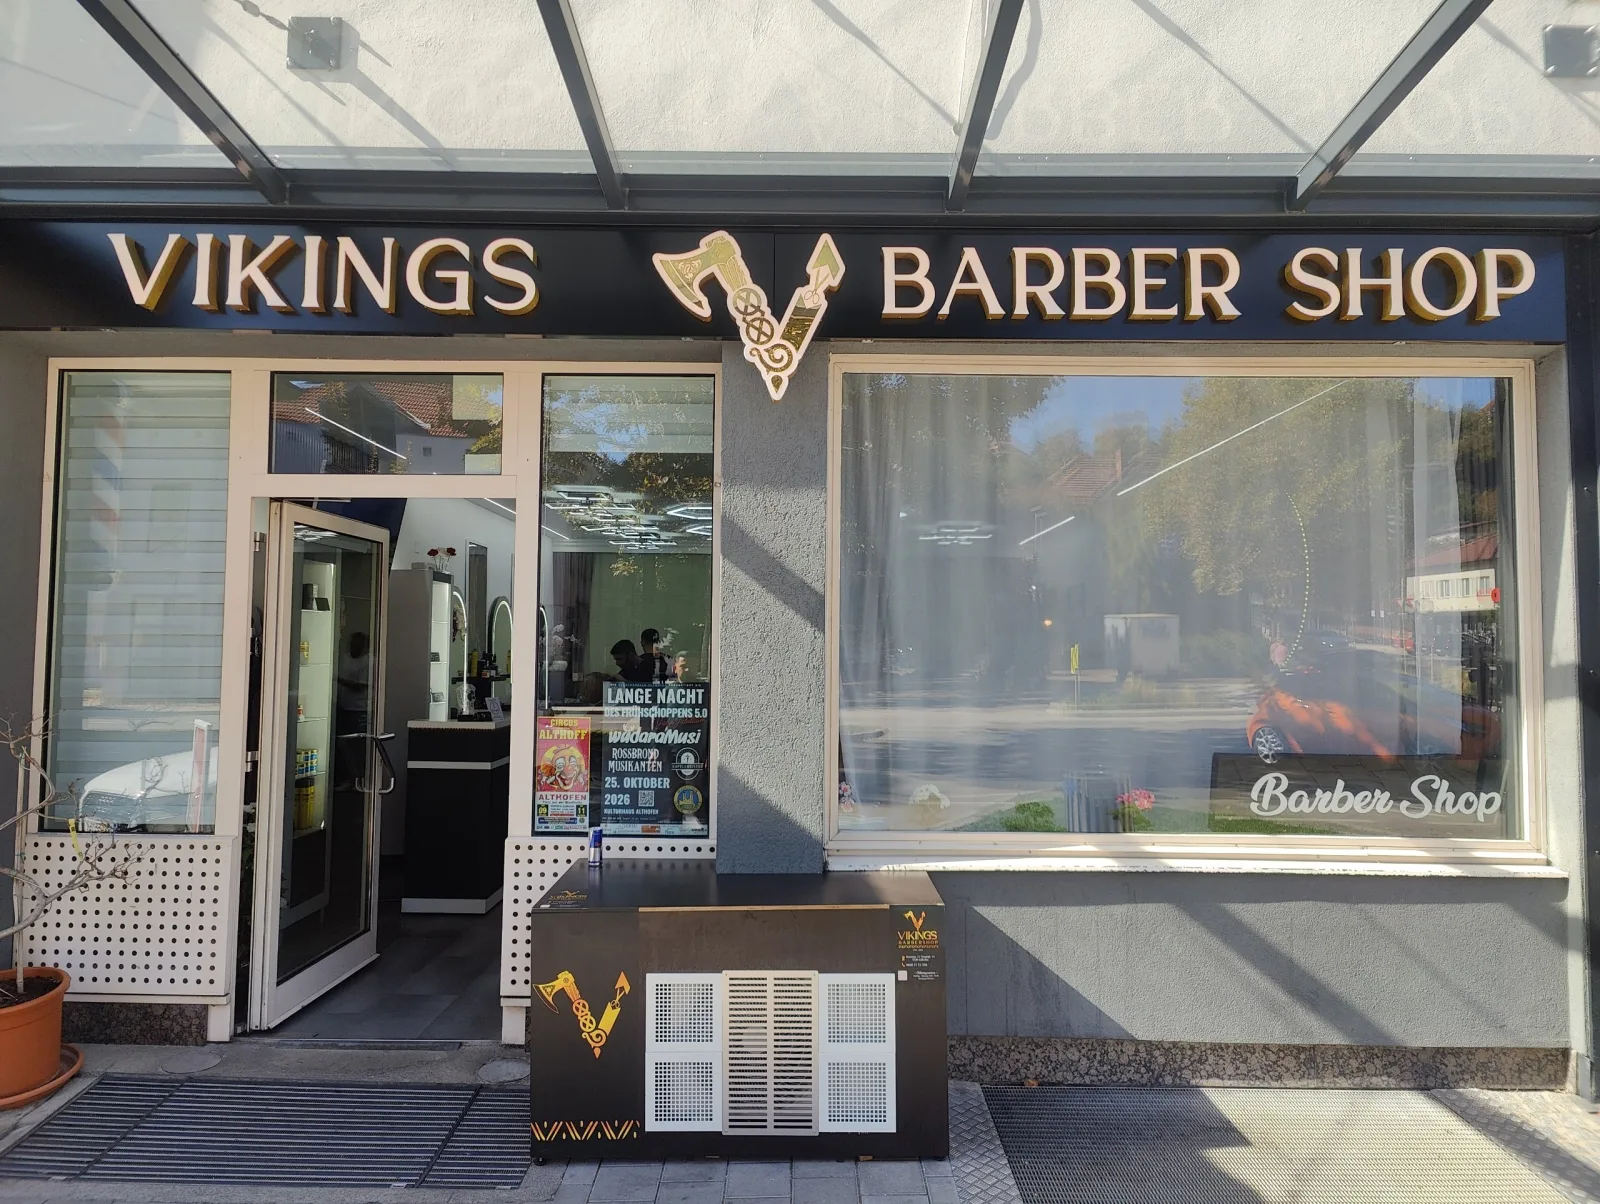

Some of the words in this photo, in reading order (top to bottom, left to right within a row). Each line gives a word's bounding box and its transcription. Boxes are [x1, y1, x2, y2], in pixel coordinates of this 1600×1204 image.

[107, 232, 540, 314] VIKINGS
[880, 246, 1241, 320] BARBER
[1284, 246, 1536, 322] SHOP
[607, 688, 653, 704] LANGE
[657, 689, 704, 705] NACHT
[604, 708, 620, 718] DES
[622, 706, 693, 719] FRÜHSCHOPPENS
[694, 709, 708, 719] 5.0
[550, 719, 579, 727] CIRCUS
[539, 729, 588, 740] ALTHOFF
[608, 760, 663, 774] MUSIKANTEN
[604, 777, 620, 789] 25.
[623, 777, 671, 789] OKTOBER
[604, 793, 631, 806] 2026
[1250, 772, 1393, 816] Barber
[1400, 775, 1501, 822] Shop
[897, 930, 938, 940] VIKINGS
